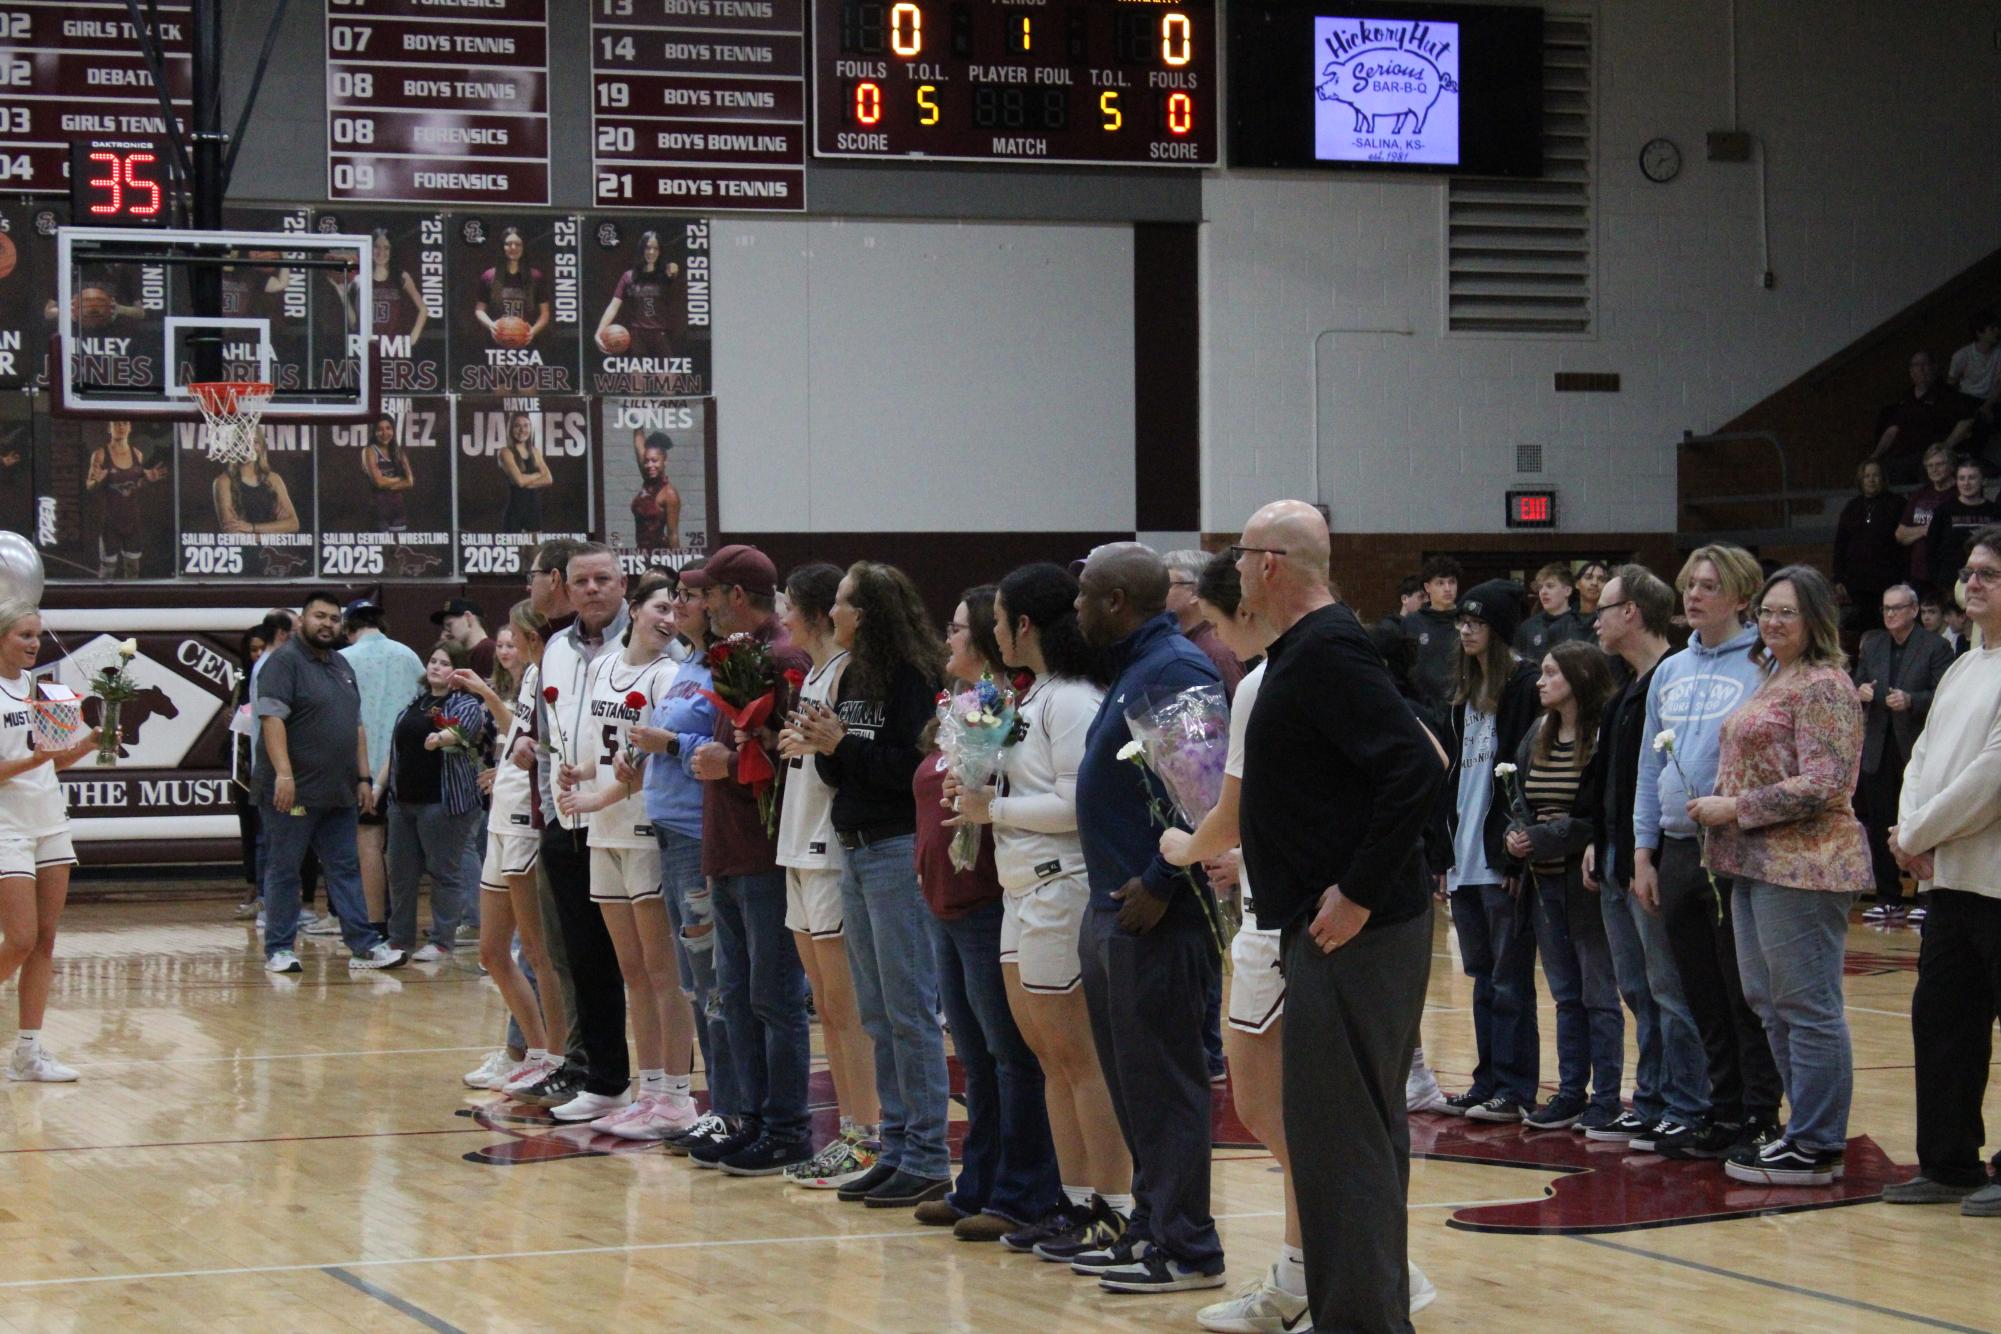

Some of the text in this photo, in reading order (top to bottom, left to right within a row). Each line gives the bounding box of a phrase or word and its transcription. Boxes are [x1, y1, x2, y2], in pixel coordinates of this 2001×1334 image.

[664, 0, 710, 16] BOYS
[714, 0, 773, 18] TENNIS
[63, 20, 118, 38] GIRLS
[121, 22, 182, 40] TCK
[332, 26, 515, 54] 07 BOYS TENNIS
[892, 3, 921, 55] 0
[1161, 13, 1190, 65] 0
[1325, 20, 1451, 61] Hickory Hut
[601, 36, 773, 62] 14 BOYS TENNIS
[87, 68, 155, 87] DEBAT
[836, 61, 887, 79] FOULS
[906, 64, 950, 82] T.O.L.
[969, 66, 1074, 85] PLAYER FOUL
[1090, 70, 1132, 87] T.O.L.
[1149, 71, 1198, 88] FOULS
[1352, 60, 1424, 93] Serious
[333, 73, 516, 99] 08 BOYS TENNIS
[597, 82, 774, 108] 19 BOYS TENNIS
[1373, 80, 1428, 94] BAR-B-Q
[856, 83, 880, 124] 0
[917, 85, 940, 126] 5
[1100, 91, 1122, 131] 5
[1168, 93, 1191, 133] 0
[61, 114, 116, 132] GIRLS
[118, 116, 184, 134] TENN
[334, 118, 508, 145] 08 FORENSICS
[598, 127, 787, 152] 20 BOYS BOWLING
[837, 133, 888, 151] SCORE
[992, 137, 1047, 155] MATCH
[1149, 142, 1198, 159] SCORE
[90, 152, 161, 214] 35
[334, 164, 508, 190] 09 FORENSICS
[598, 173, 788, 198] 21 BOYS TENNIS
[421, 251, 443, 318] SENIOR
[555, 253, 577, 323] SENIOR
[687, 256, 709, 326] SENIOR
[347, 334, 412, 358] RMI
[485, 349, 543, 366] TESSA
[460, 365, 572, 391] SNYDER
[603, 357, 693, 374] CHARLIZE
[593, 374, 702, 393] WALTMAN
[613, 408, 693, 429] JONES
[1521, 497, 1547, 521] EXIT
[182, 533, 313, 547] SALINA CENTRAL WRESTLING
[323, 532, 449, 545] SALINA CENTRAL WRESTLING
[461, 533, 494, 546] SALINA
[495, 533, 535, 546] CENTRAL
[185, 546, 243, 574] 2025
[323, 545, 384, 574] 2025
[464, 546, 520, 573] 2025
[599, 724, 619, 766] 5
[61, 781, 127, 807] THE
